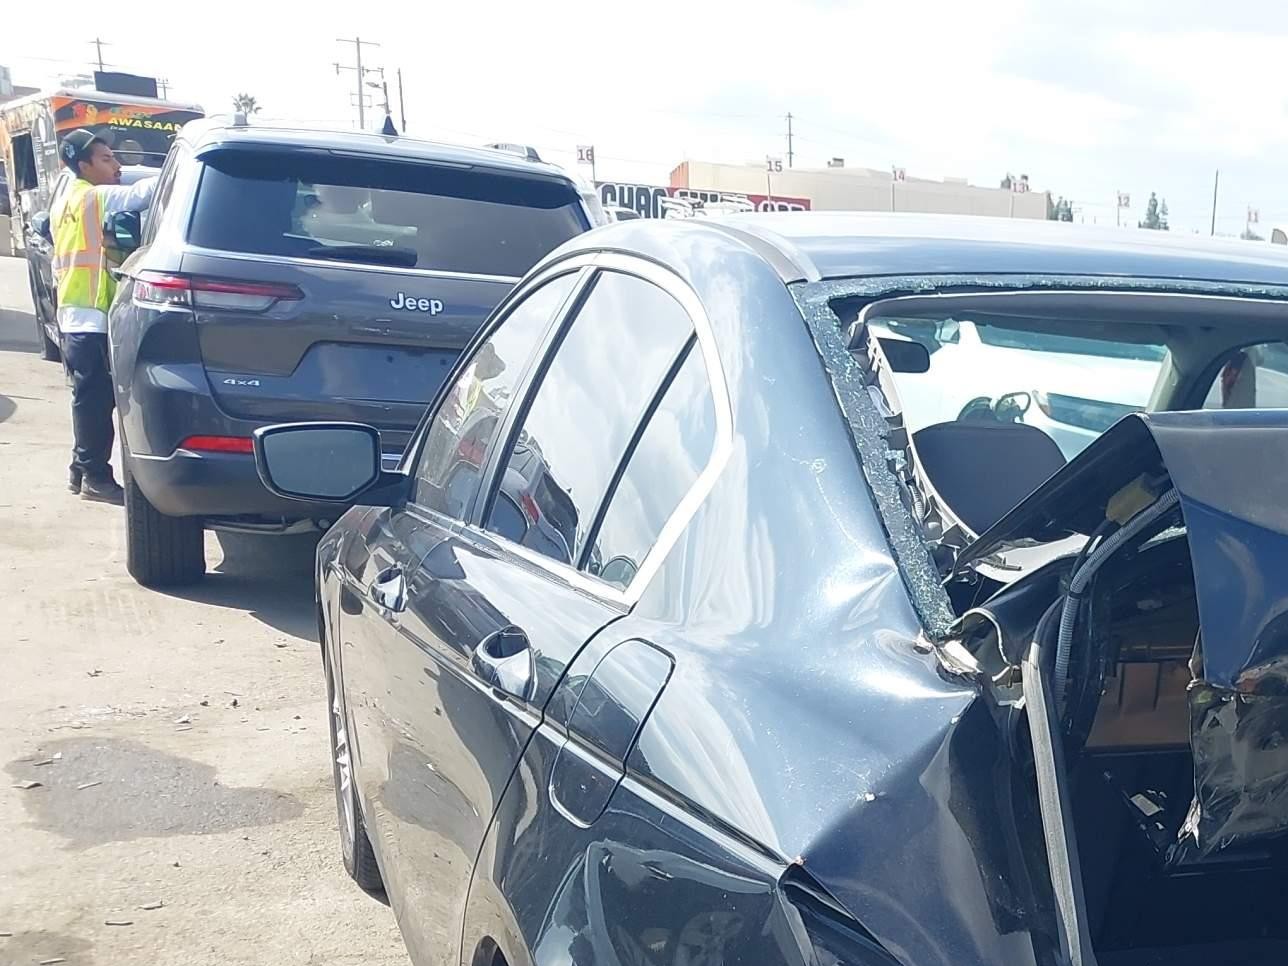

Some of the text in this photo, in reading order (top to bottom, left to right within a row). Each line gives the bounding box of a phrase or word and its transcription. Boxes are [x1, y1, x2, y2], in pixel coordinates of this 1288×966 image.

[767, 160, 783, 172] 15
[892, 170, 905, 181] 14
[1117, 195, 1130, 207] 12
[390, 292, 443, 315] Jeep
[223, 378, 260, 386] 4x4
